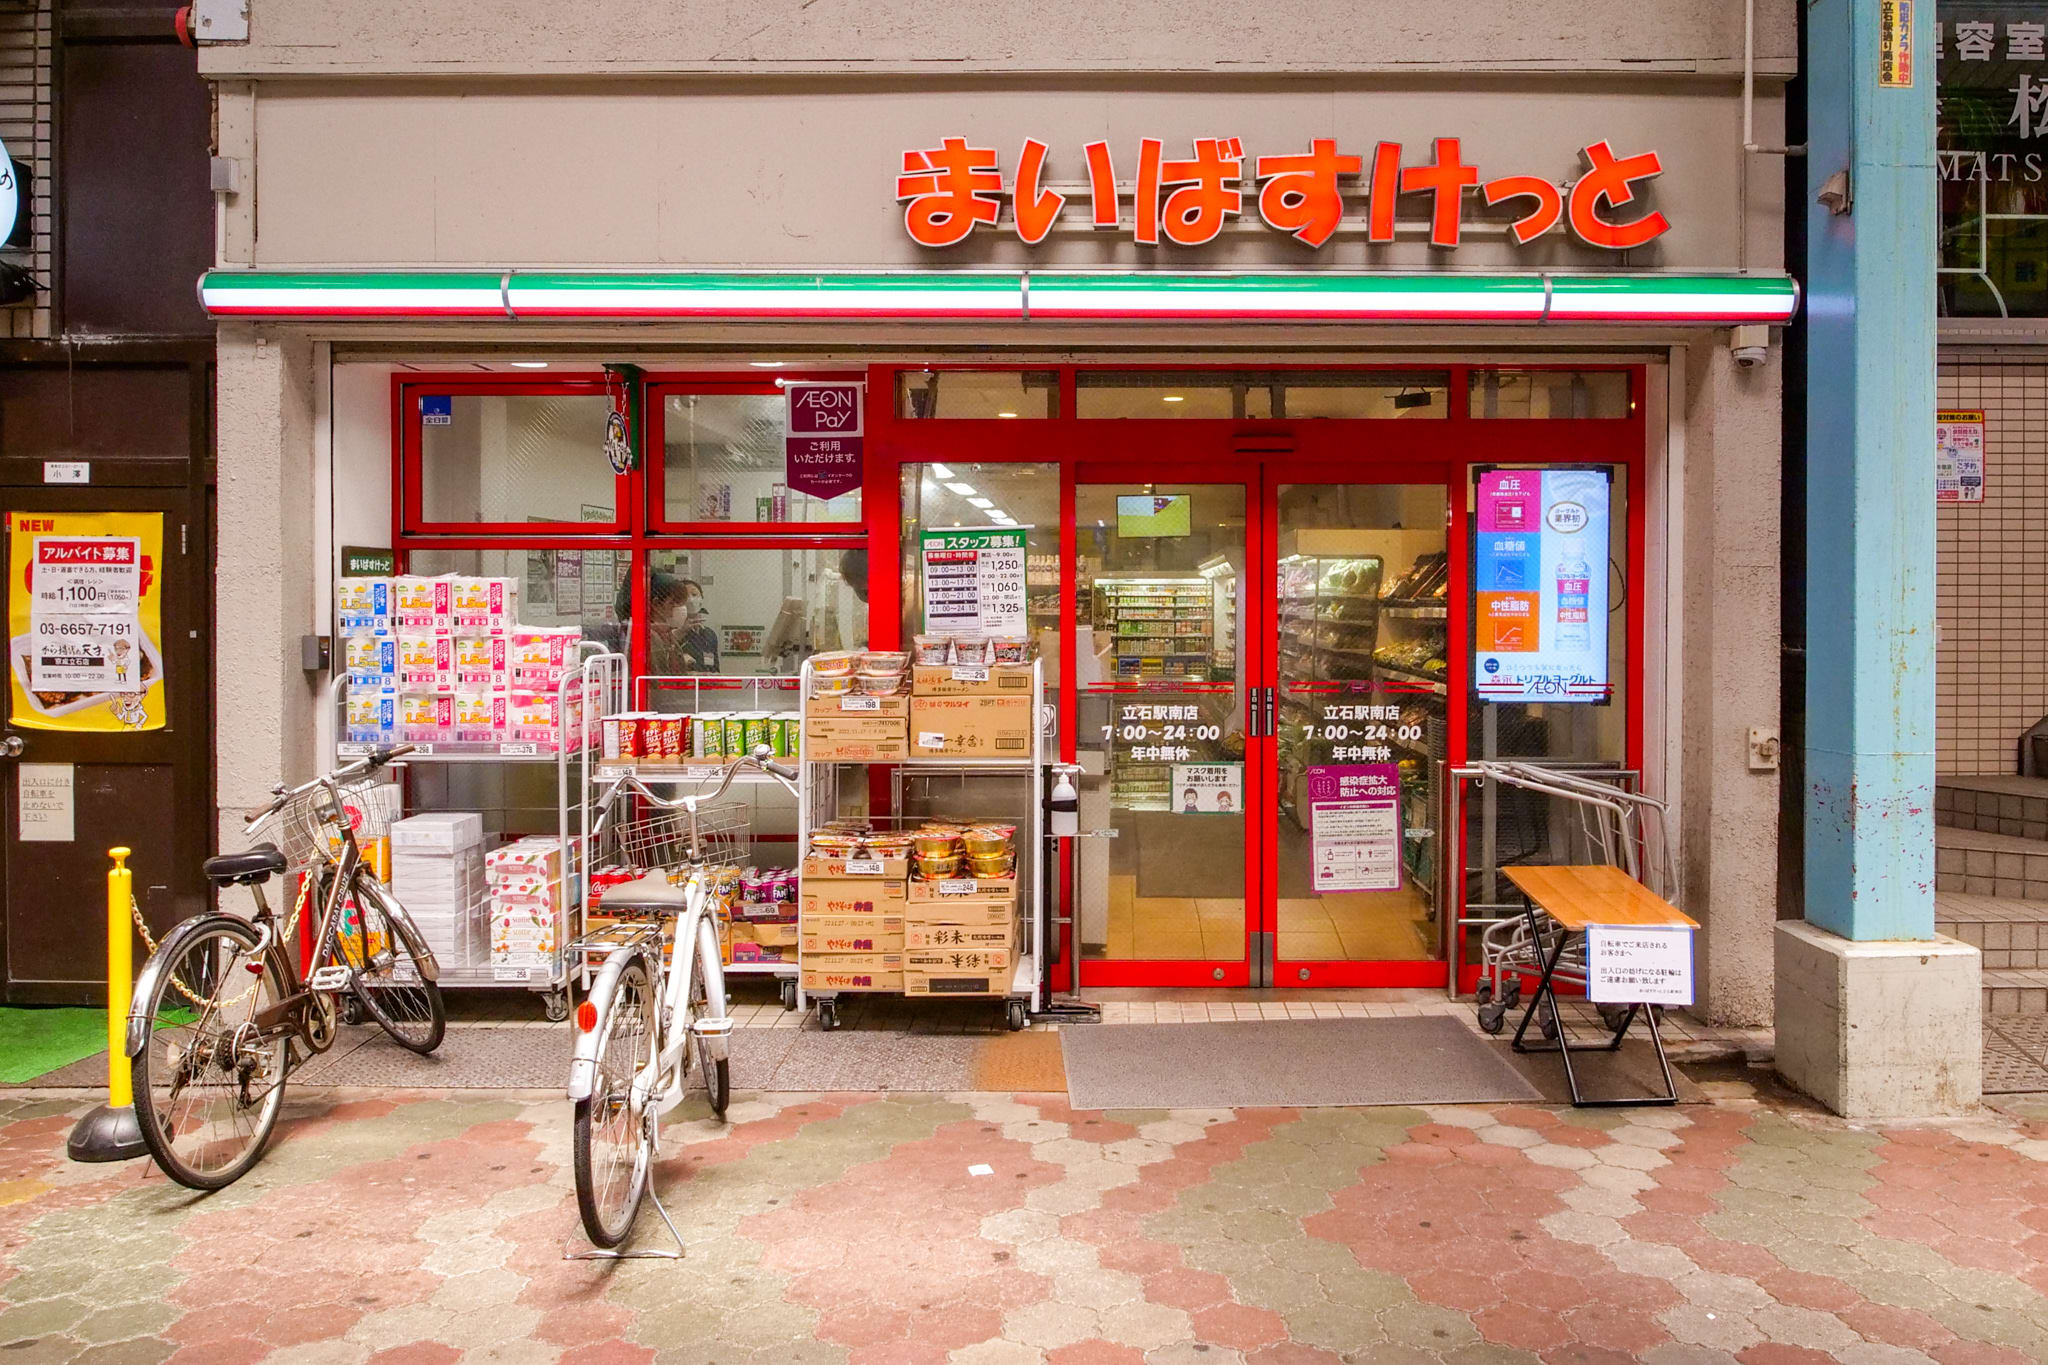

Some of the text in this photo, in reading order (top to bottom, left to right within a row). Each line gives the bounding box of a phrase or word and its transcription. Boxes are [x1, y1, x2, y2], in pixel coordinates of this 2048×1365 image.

[895, 136, 1671, 249] まいばすけっと
[815, 410, 851, 428] Pay
[810, 441, 841, 451] ご利用
[794, 453, 856, 463] いただけます。
[1499, 480, 1520, 490] 血圧
[19, 519, 55, 532] NEW
[1494, 540, 1526, 551] 血糖値
[43, 546, 130, 560] アルバイト募集
[350, 558, 390, 571] まいばすけっと
[1491, 600, 1530, 612] 中性脂肪
[40, 623, 131, 635] 03-6657-7191
[1122, 705, 1198, 720] 立石駅南店
[1324, 705, 1400, 720] 立石駅南店
[1131, 746, 1190, 761] 年中無休
[1332, 746, 1391, 761] 年中無休
[1339, 775, 1388, 786] 感染症拡大
[1340, 786, 1397, 797] 防止への対応
[1601, 940, 1668, 949] 自転車でご来店される
[1601, 967, 1682, 976] 出入口の妨げになる駐輪は
[1601, 976, 1666, 984] ご遠慮お願い致します
